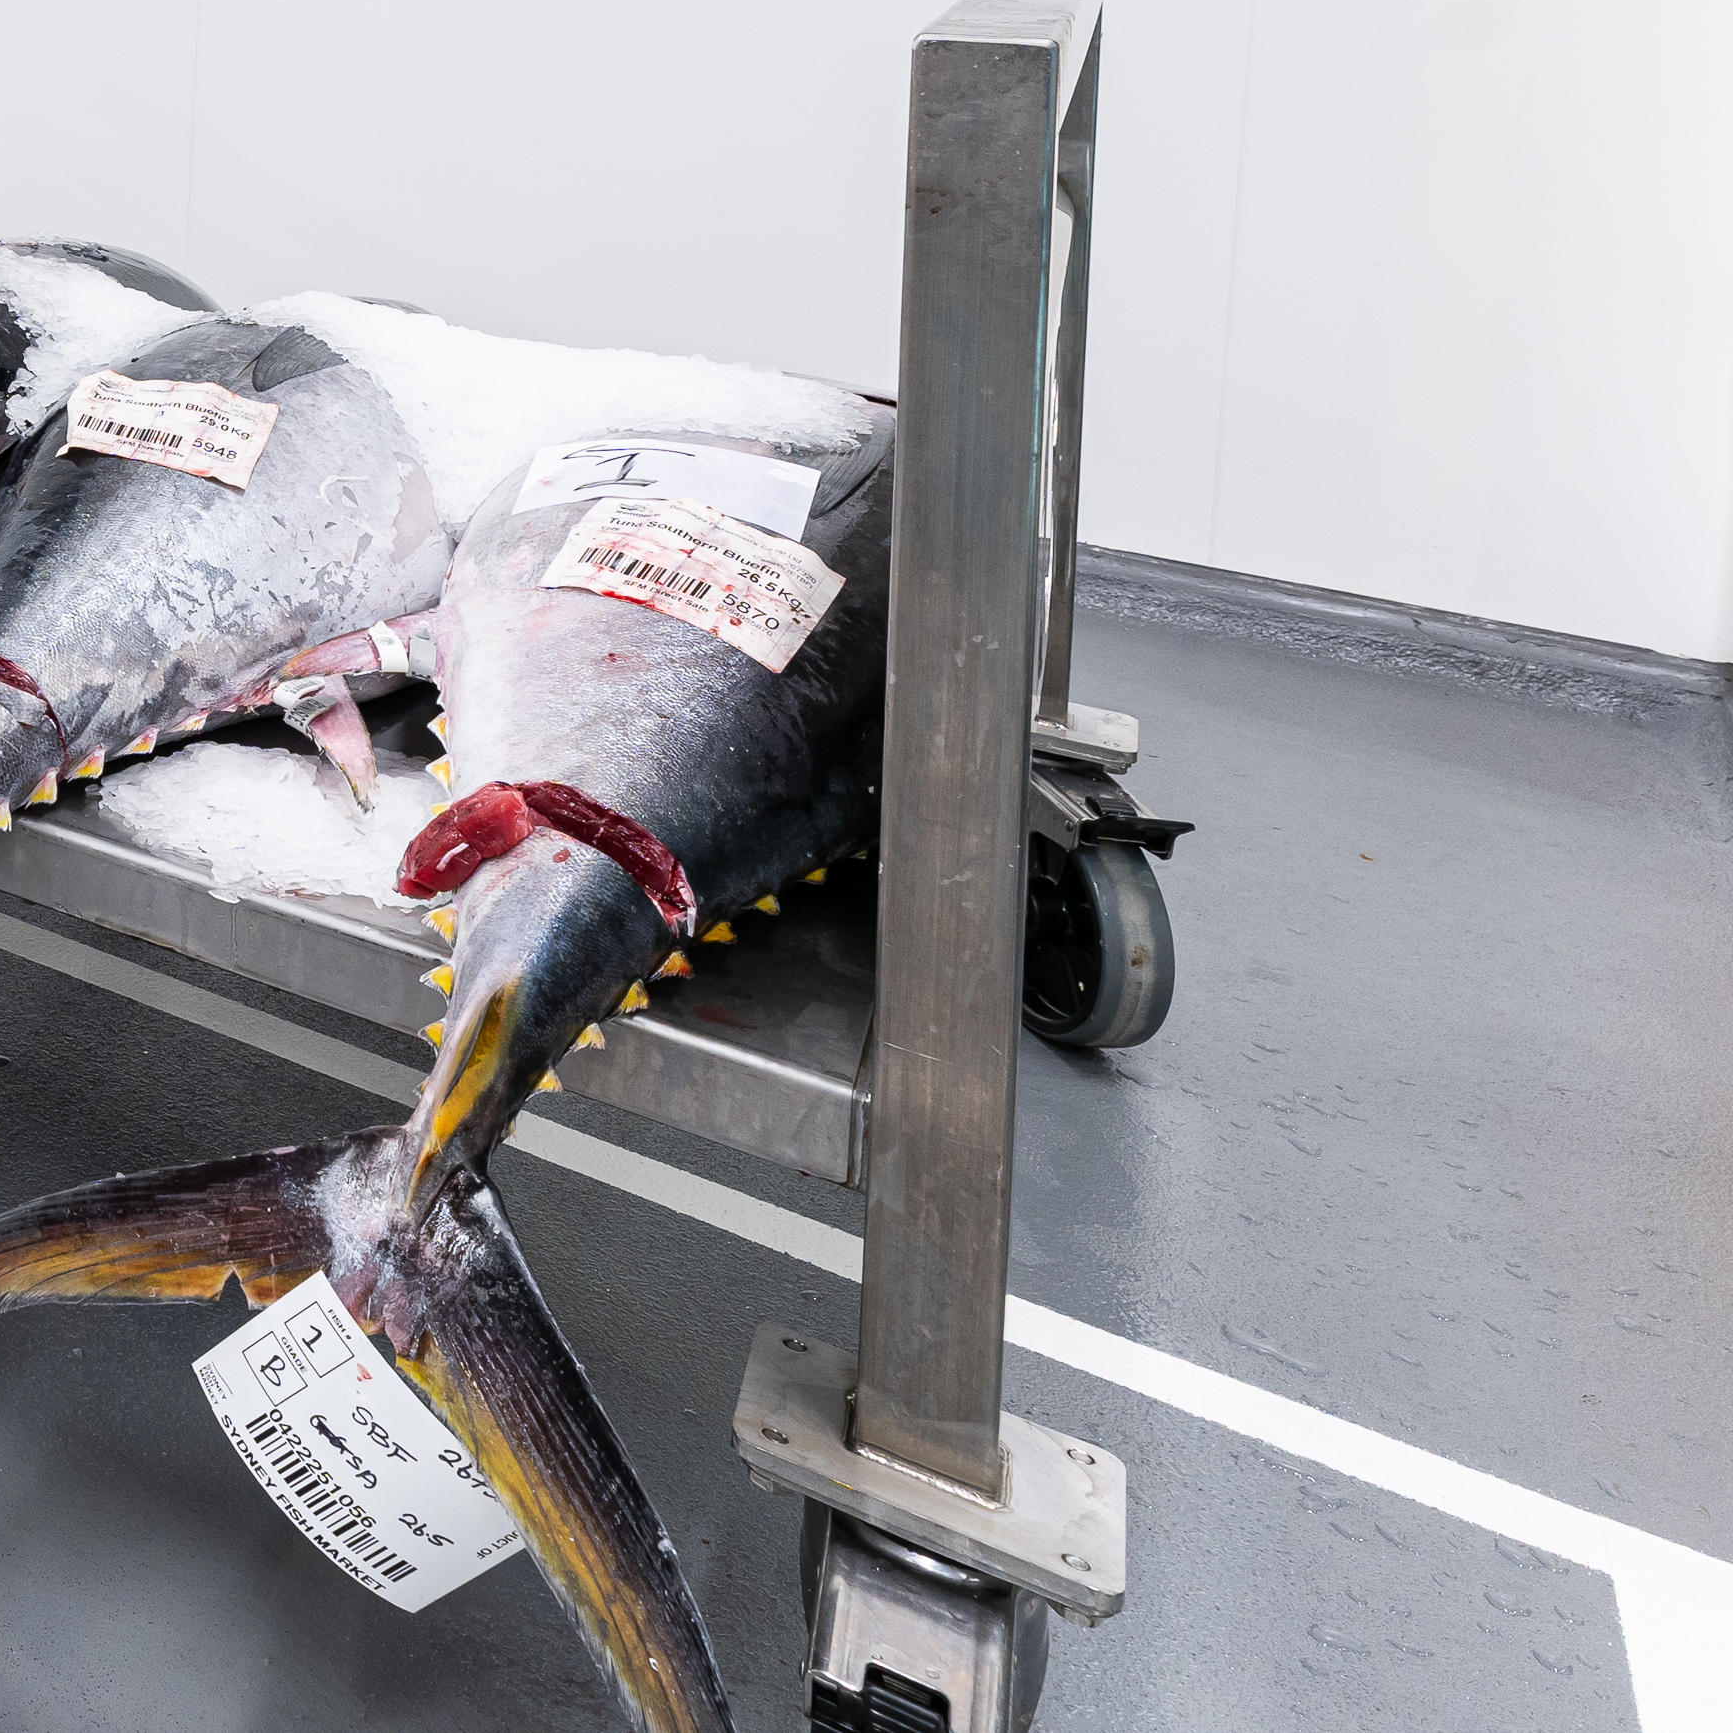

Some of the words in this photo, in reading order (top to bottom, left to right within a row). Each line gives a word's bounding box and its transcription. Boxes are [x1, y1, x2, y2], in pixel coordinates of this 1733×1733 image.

[93, 392, 121, 404] Tuna
[184, 403, 230, 423] Bluefin
[192, 437, 238, 460] 5948
[608, 516, 643, 529] Tuna
[646, 519, 719, 552] Southern
[722, 548, 782, 580] Bluefin
[621, 578, 647, 590] SFM
[649, 586, 683, 603] Direct
[684, 598, 710, 614] Sale
[721, 592, 781, 631] 5870
[327, 1308, 347, 1334] FISH
[260, 1354, 286, 1387] B
[279, 1336, 308, 1374] GRADE
[198, 1369, 220, 1406] MARKET
[205, 1363, 228, 1400] SYDNEY
[351, 1405, 417, 1464] SBF
[269, 1407, 378, 1529] 0422251056
[220, 1414, 277, 1489] SYDNEY
[275, 1492, 313, 1534] FISH
[313, 1533, 387, 1593] MARKET
[476, 1547, 493, 1560] OF
